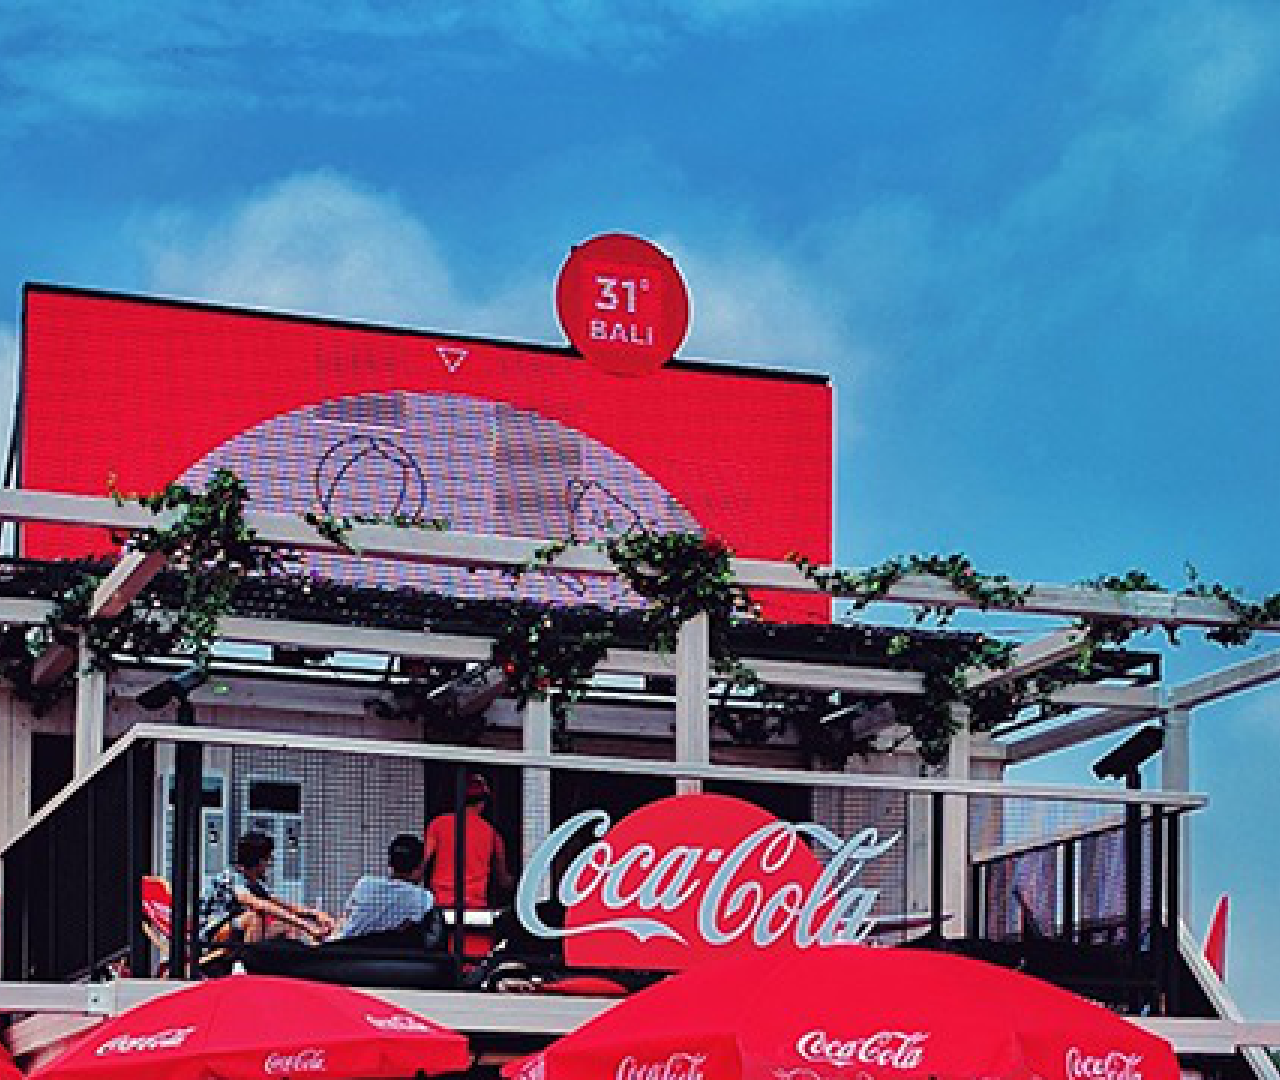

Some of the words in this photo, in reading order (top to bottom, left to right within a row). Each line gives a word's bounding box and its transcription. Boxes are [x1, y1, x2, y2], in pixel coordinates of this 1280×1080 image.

[589, 318, 653, 346] BALI
[515, 809, 902, 949] Coca-Cola
[796, 1030, 929, 1070] Coca-Cola
